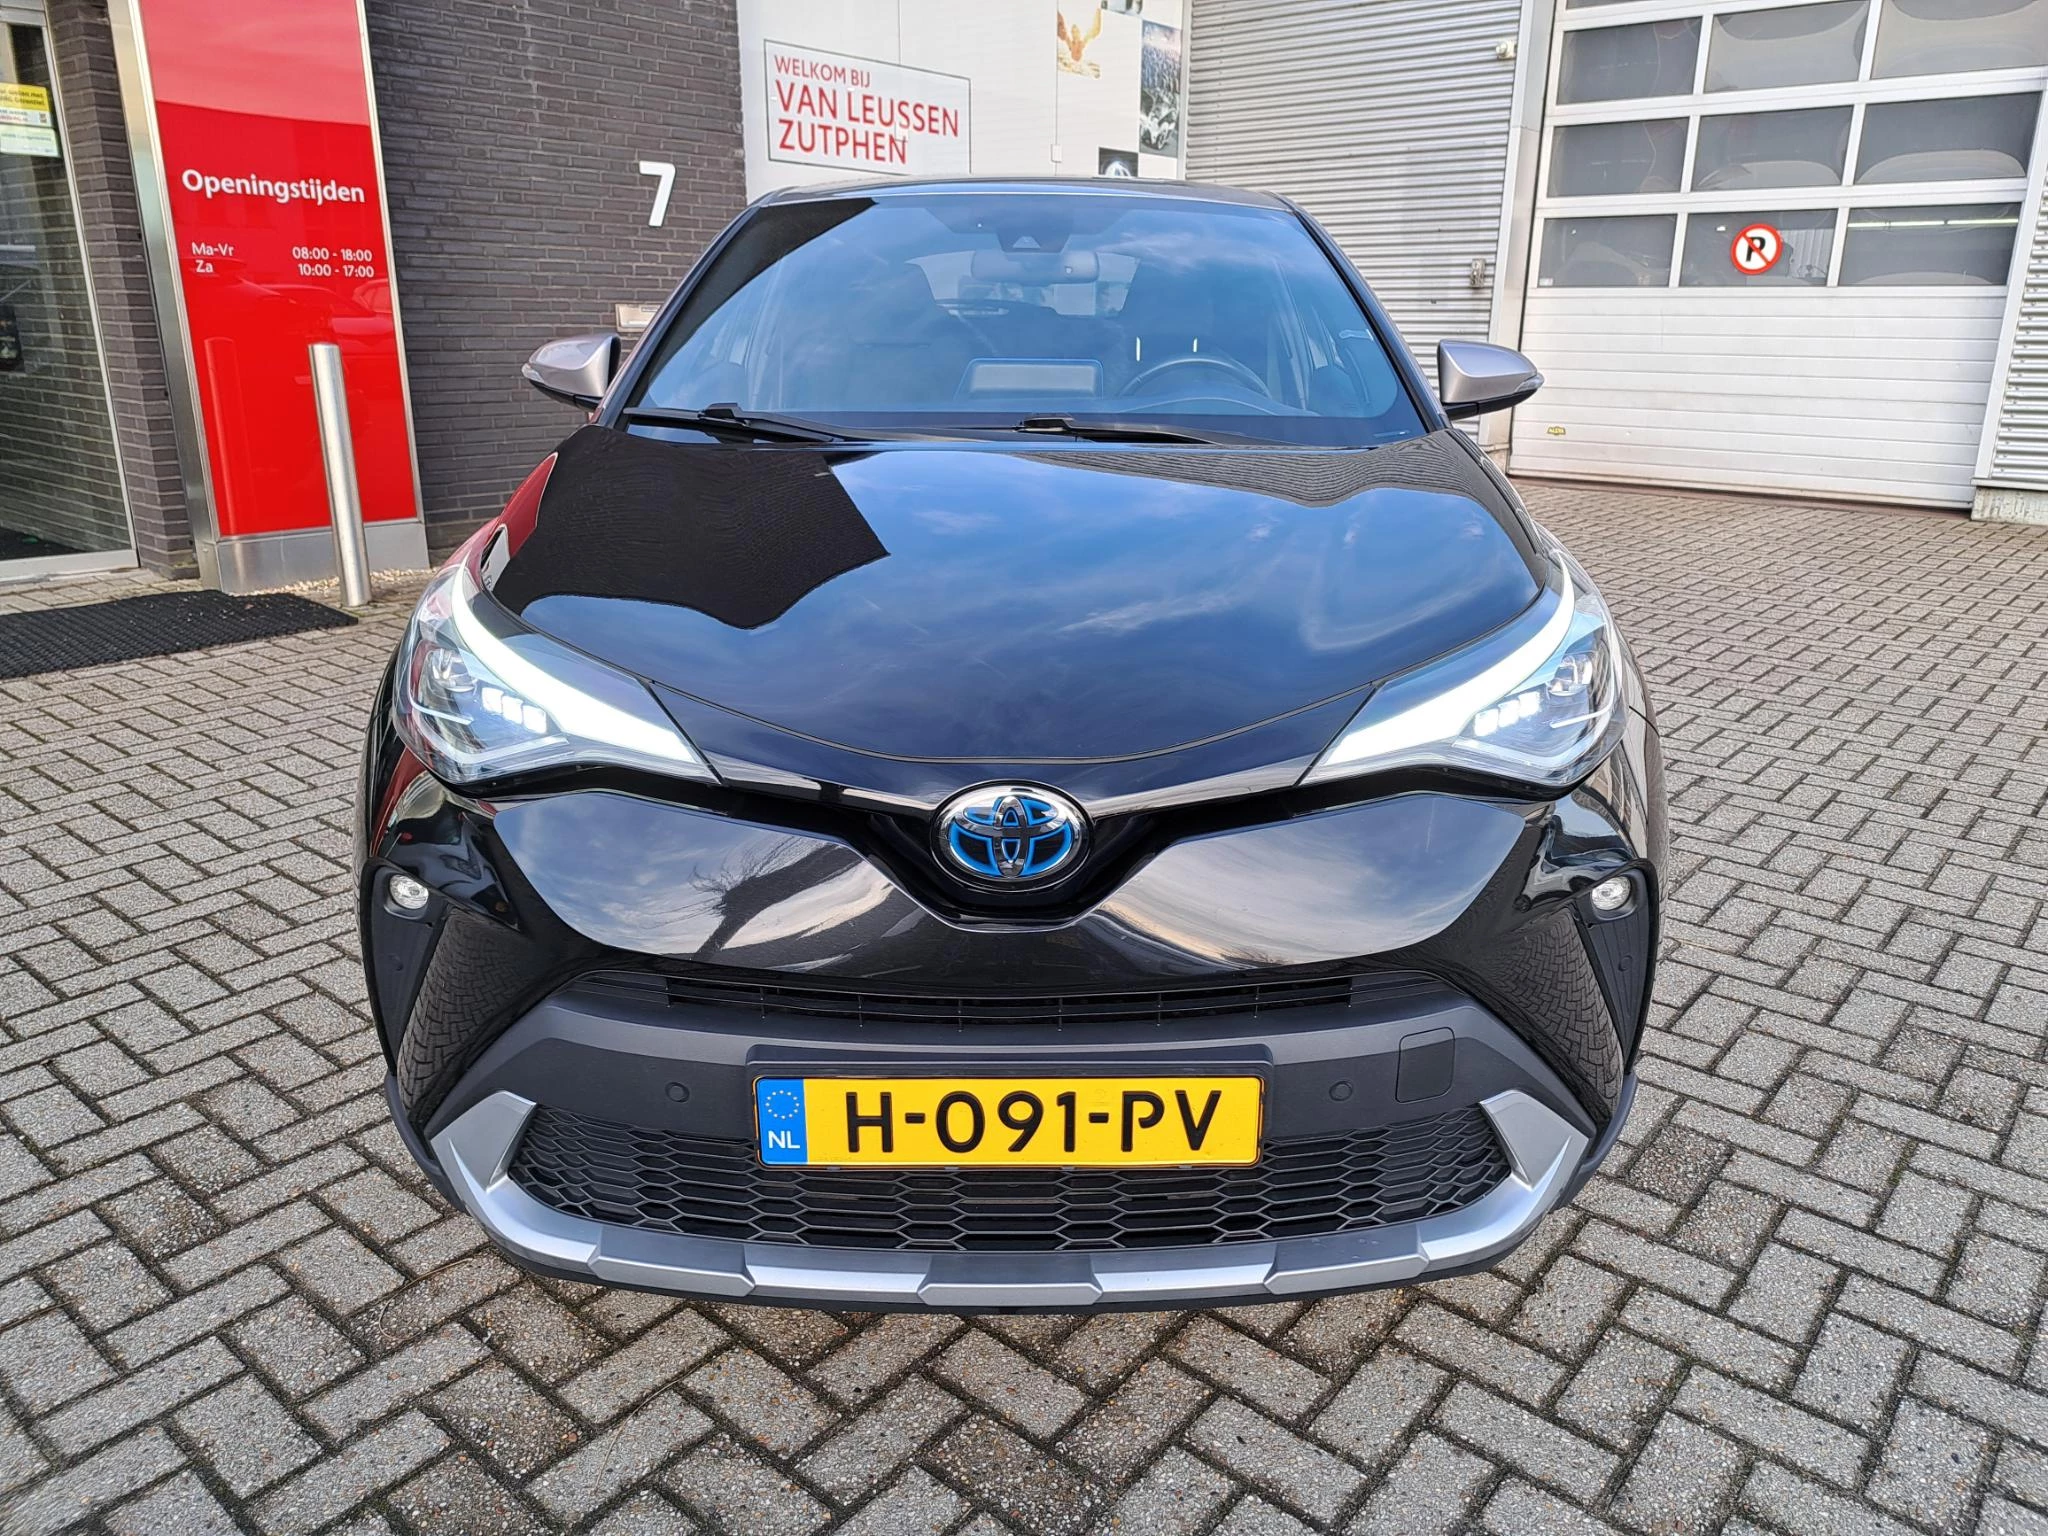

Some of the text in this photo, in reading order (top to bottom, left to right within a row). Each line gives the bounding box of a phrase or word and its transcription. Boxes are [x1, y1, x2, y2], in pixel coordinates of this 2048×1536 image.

[774, 54, 870, 88] WELKOM BIJ
[775, 79, 959, 138] VAN LEUSSEN
[778, 118, 908, 165] ZUTPHEN
[182, 169, 366, 206] Openingstijden
[638, 161, 676, 227] 7
[191, 242, 235, 257] Ma-Vr
[292, 246, 329, 260] 08:00
[340, 248, 373, 262] 18:00
[1746, 236, 1766, 262] P
[195, 260, 213, 274] Za
[298, 263, 332, 277] 10:00
[343, 265, 375, 278] 17:00
[844, 1089, 1222, 1154] H-091-PV
[768, 1130, 801, 1150] NL
